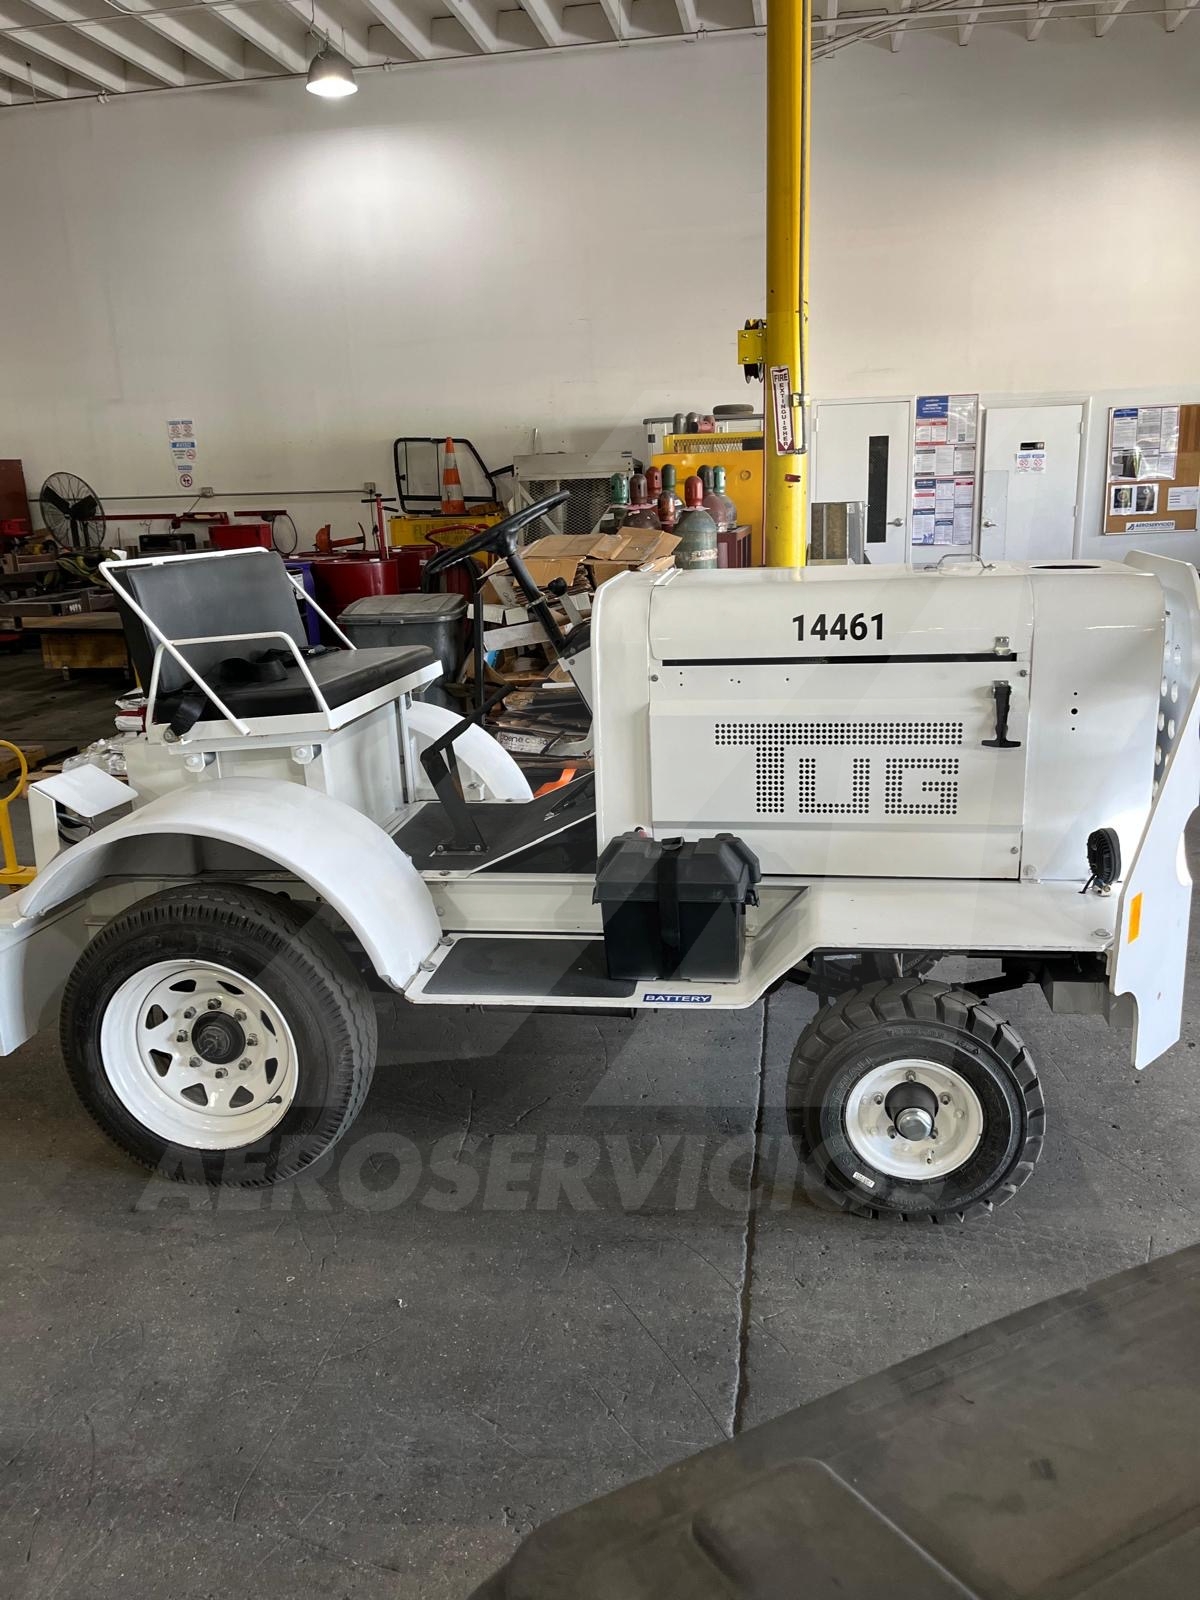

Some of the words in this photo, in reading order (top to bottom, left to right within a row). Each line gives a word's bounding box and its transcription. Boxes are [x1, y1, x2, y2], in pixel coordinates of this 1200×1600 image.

[774, 373, 789, 382] FIRE
[779, 382, 789, 447] EXTINGUISHER
[792, 612, 883, 641] 14461
[714, 721, 964, 815] TUG
